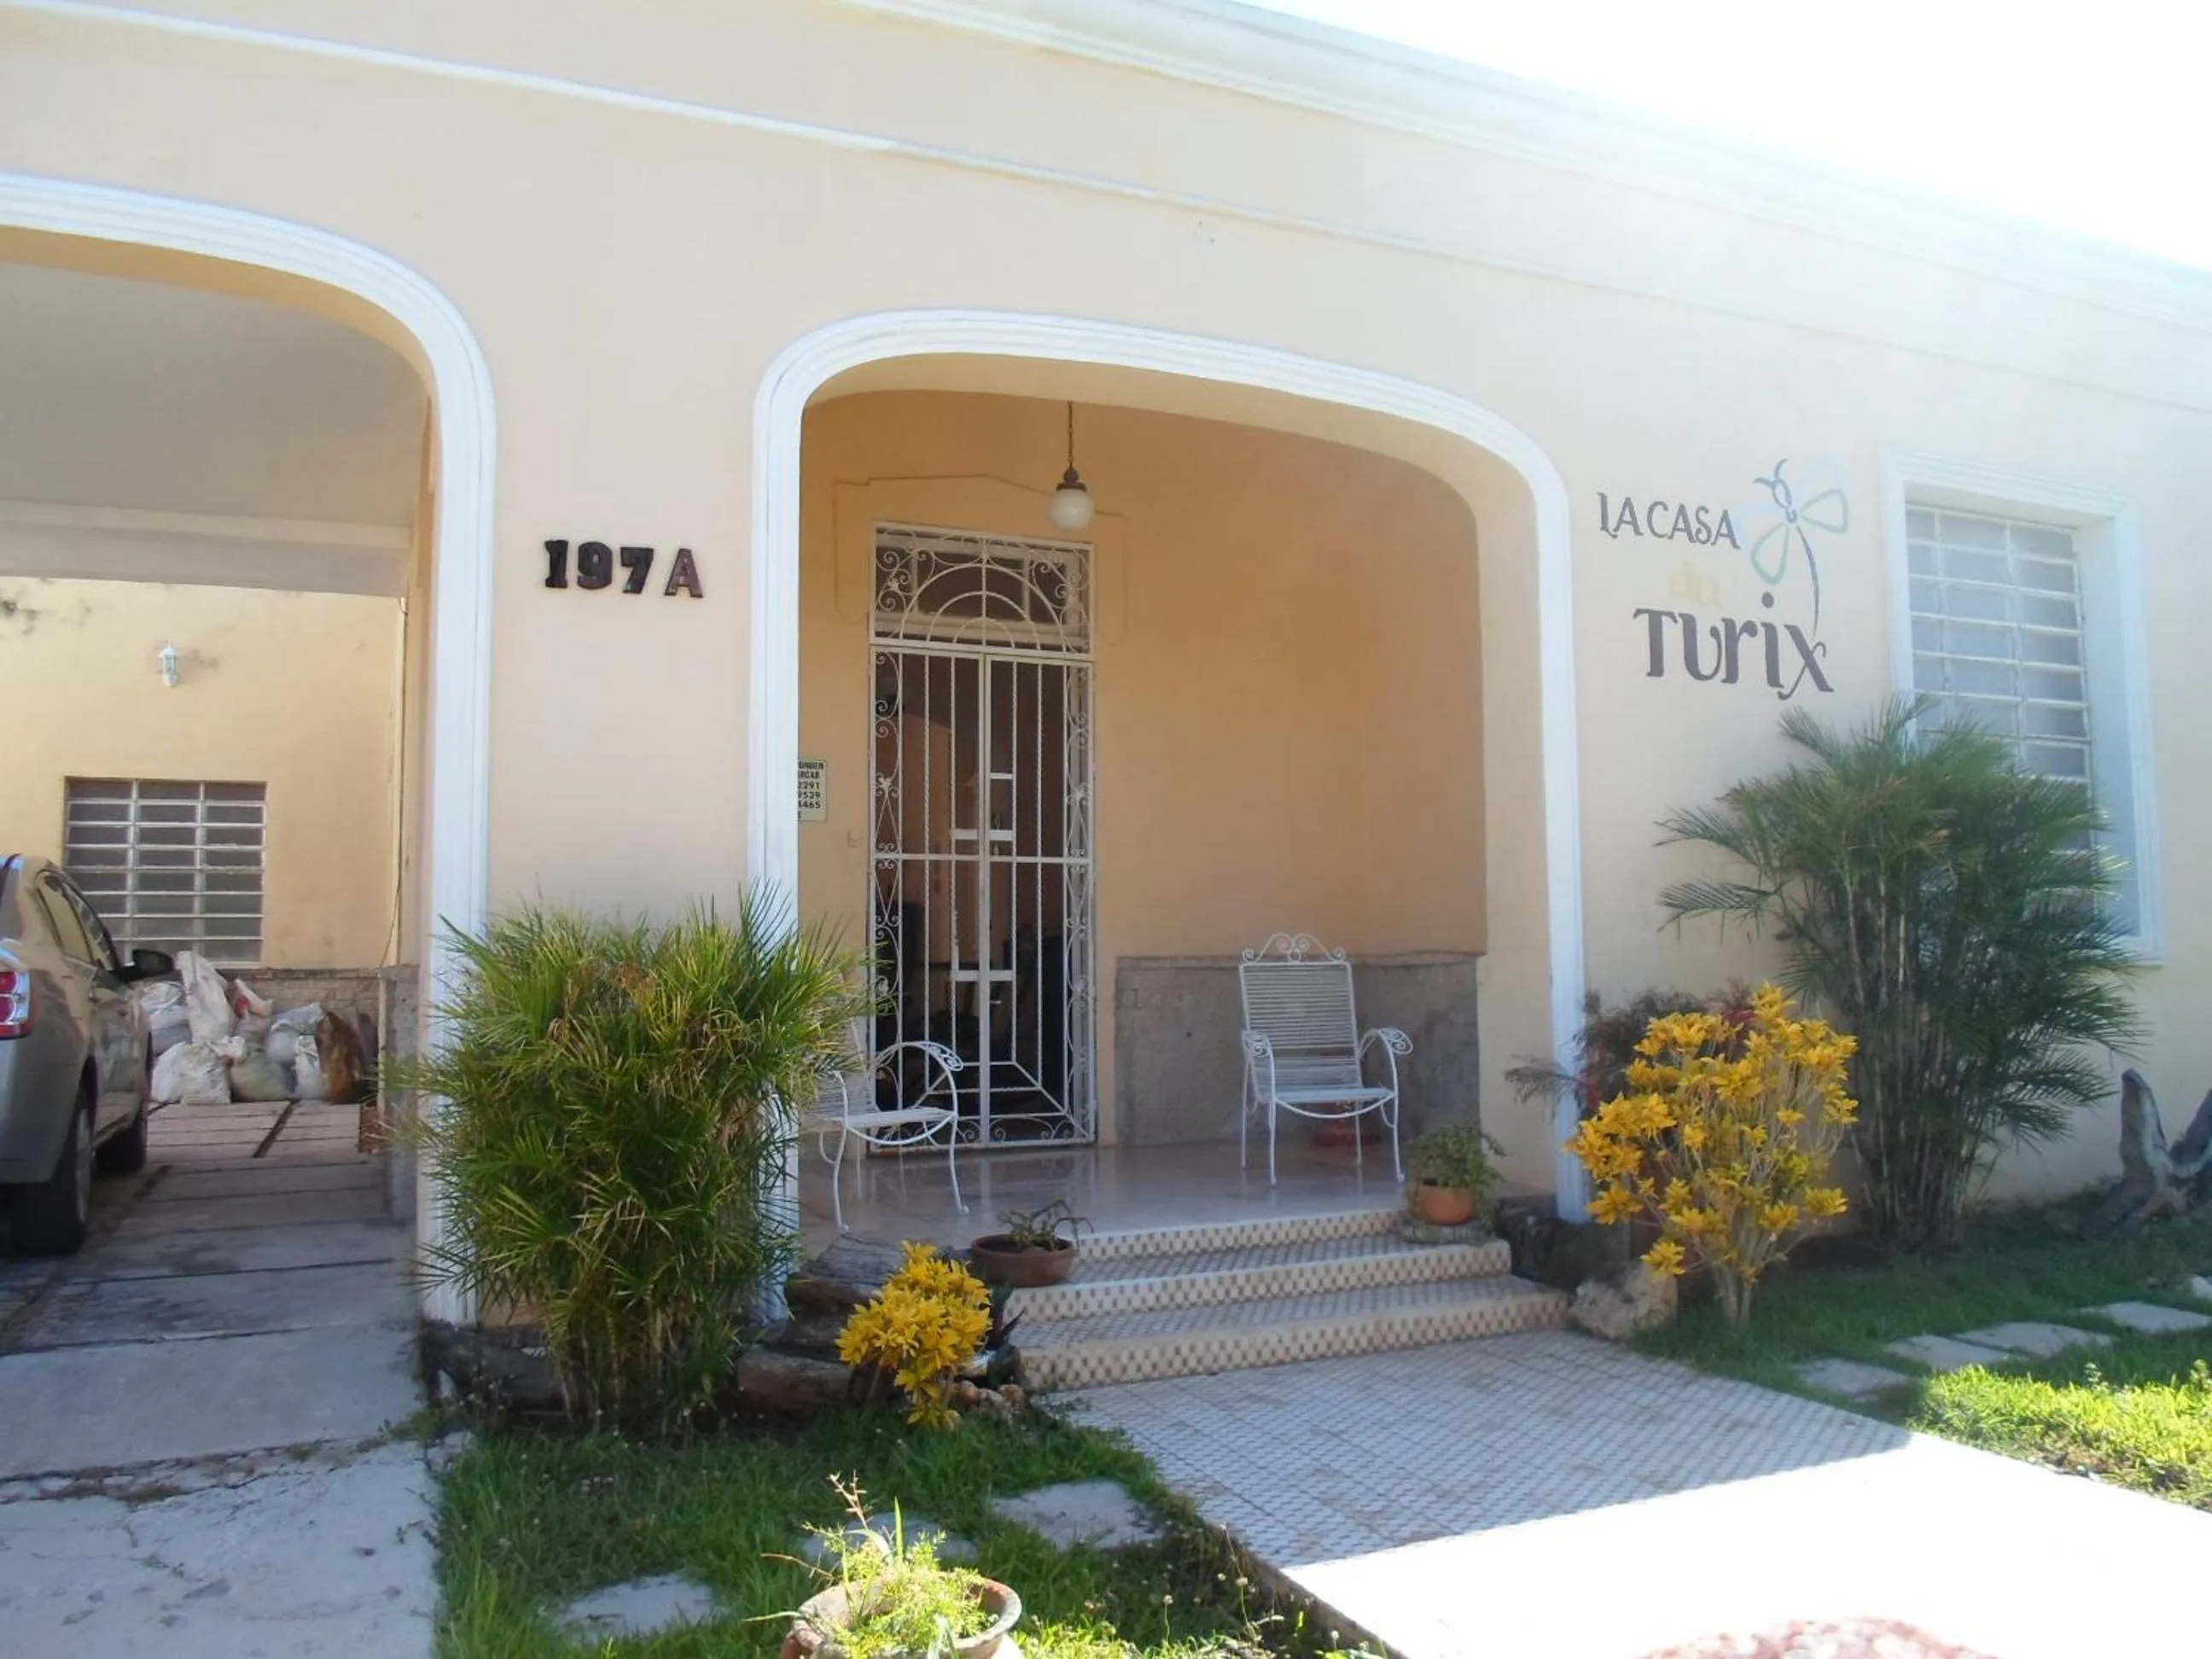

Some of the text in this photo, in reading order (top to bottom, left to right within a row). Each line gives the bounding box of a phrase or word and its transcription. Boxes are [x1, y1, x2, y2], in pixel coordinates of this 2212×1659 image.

[1598, 492, 1741, 550] LA CASA
[544, 539, 703, 598] 197A
